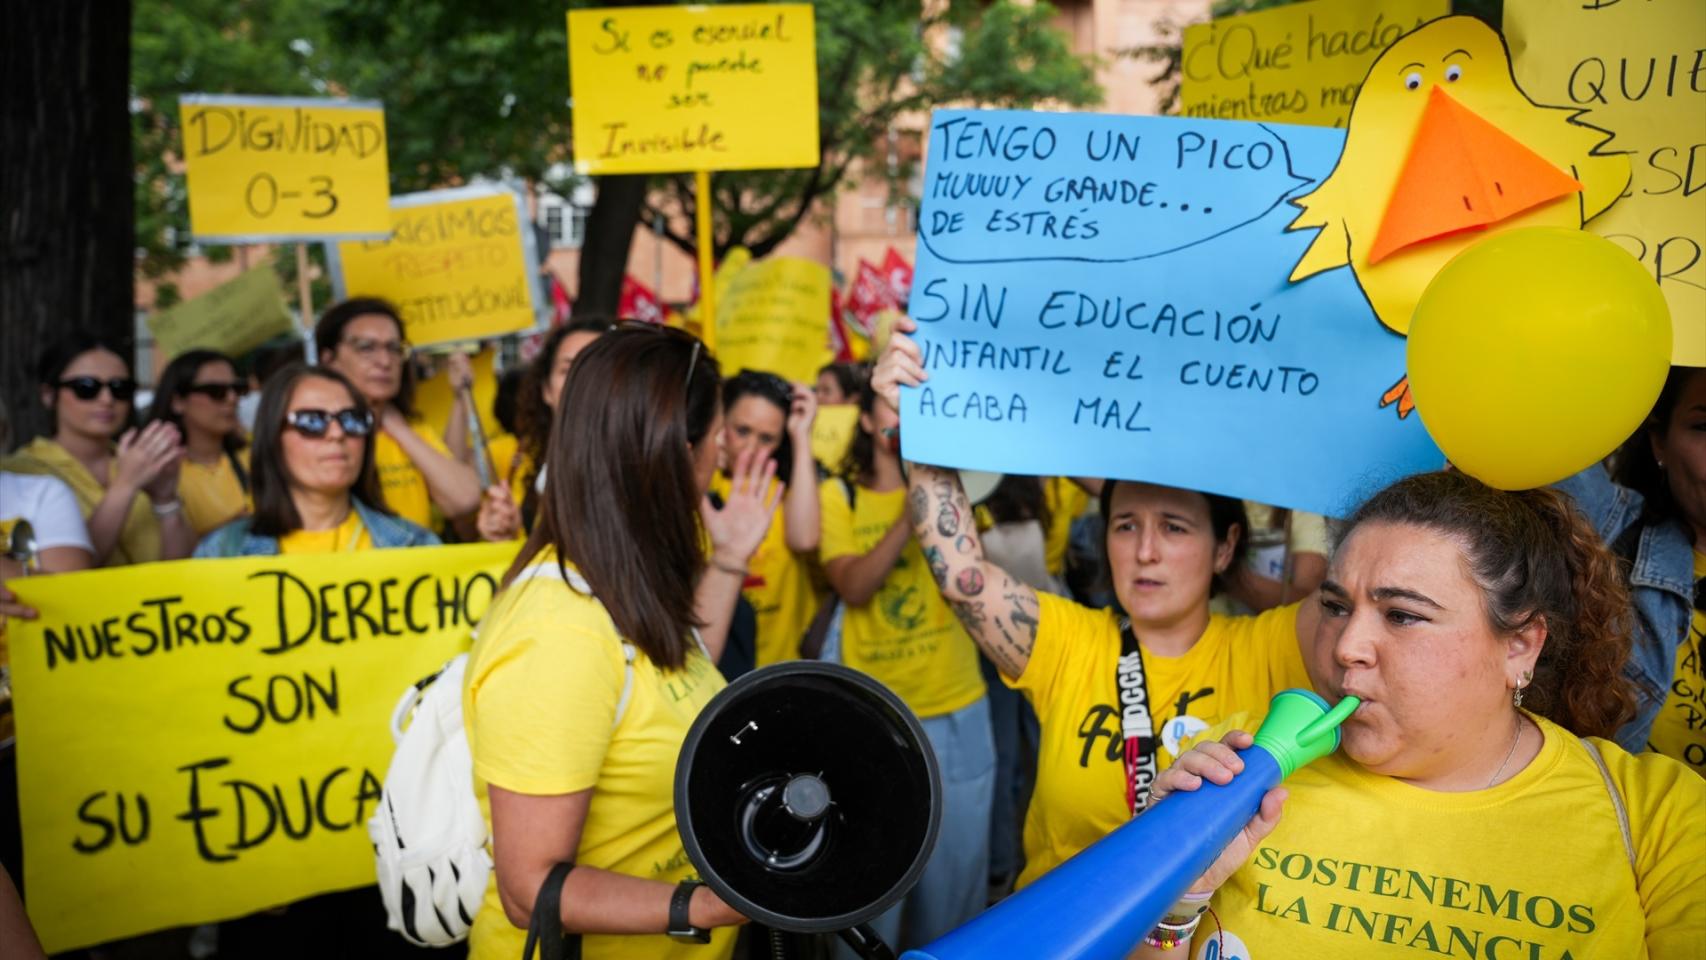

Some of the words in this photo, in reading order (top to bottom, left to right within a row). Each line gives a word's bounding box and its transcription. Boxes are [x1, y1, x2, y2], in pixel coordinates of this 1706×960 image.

[649, 28, 674, 49] es
[692, 13, 791, 45] esencial
[1306, 13, 1425, 61] hacía
[636, 63, 667, 83] no
[686, 51, 763, 89] puede
[666, 92, 712, 109] ser
[597, 122, 728, 159] Invisible
[934, 116, 1057, 162] TENGO
[1086, 130, 1140, 162] UN
[1176, 131, 1274, 170] PICO
[245, 172, 340, 219] 0-3
[1044, 177, 1213, 214] GRANDE...
[931, 210, 965, 236] DE
[986, 208, 1100, 240] ESTRÉS
[915, 278, 1008, 330] SIN
[1038, 290, 1282, 344] EDUCACIÓN
[921, 339, 1071, 375] INFANTIL
[1103, 351, 1144, 381] EL
[1180, 360, 1320, 397] CUENTO
[919, 387, 1029, 423] ACABA
[1073, 396, 1151, 432] MAL
[43, 596, 251, 670] NUESTROS
[222, 668, 340, 735] SON
[71, 791, 151, 854] SU
[1252, 882, 1312, 925] LA
[1253, 846, 1596, 935] SOSTENEMOS
